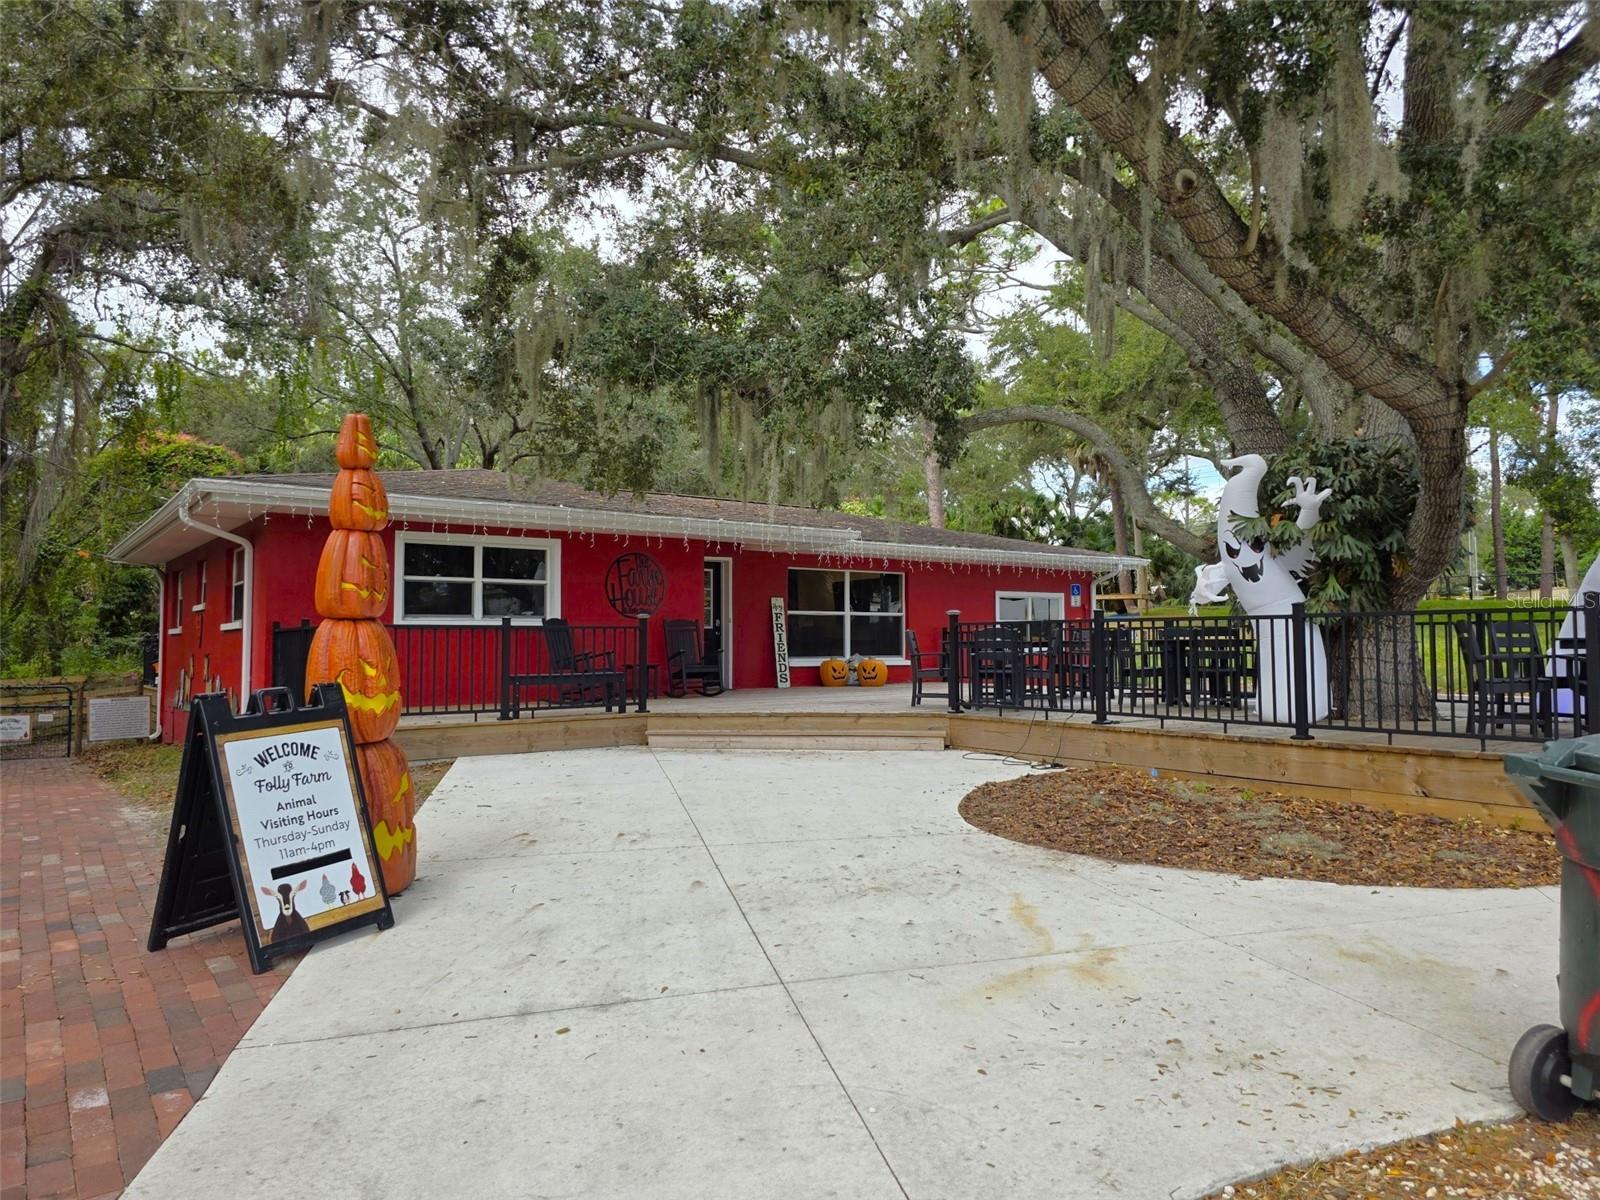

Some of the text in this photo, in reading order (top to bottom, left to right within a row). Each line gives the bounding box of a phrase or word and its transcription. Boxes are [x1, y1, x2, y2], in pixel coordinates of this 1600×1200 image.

[774, 612, 789, 684] FRIENDS
[253, 742, 320, 768] WELCOME
[254, 771, 331, 793] Folly Farm
[277, 794, 317, 812] Animal
[260, 807, 339, 830] Visiting Hours
[254, 820, 350, 849] Thursday-Sunday
[279, 839, 336, 860] 11am-4pm
